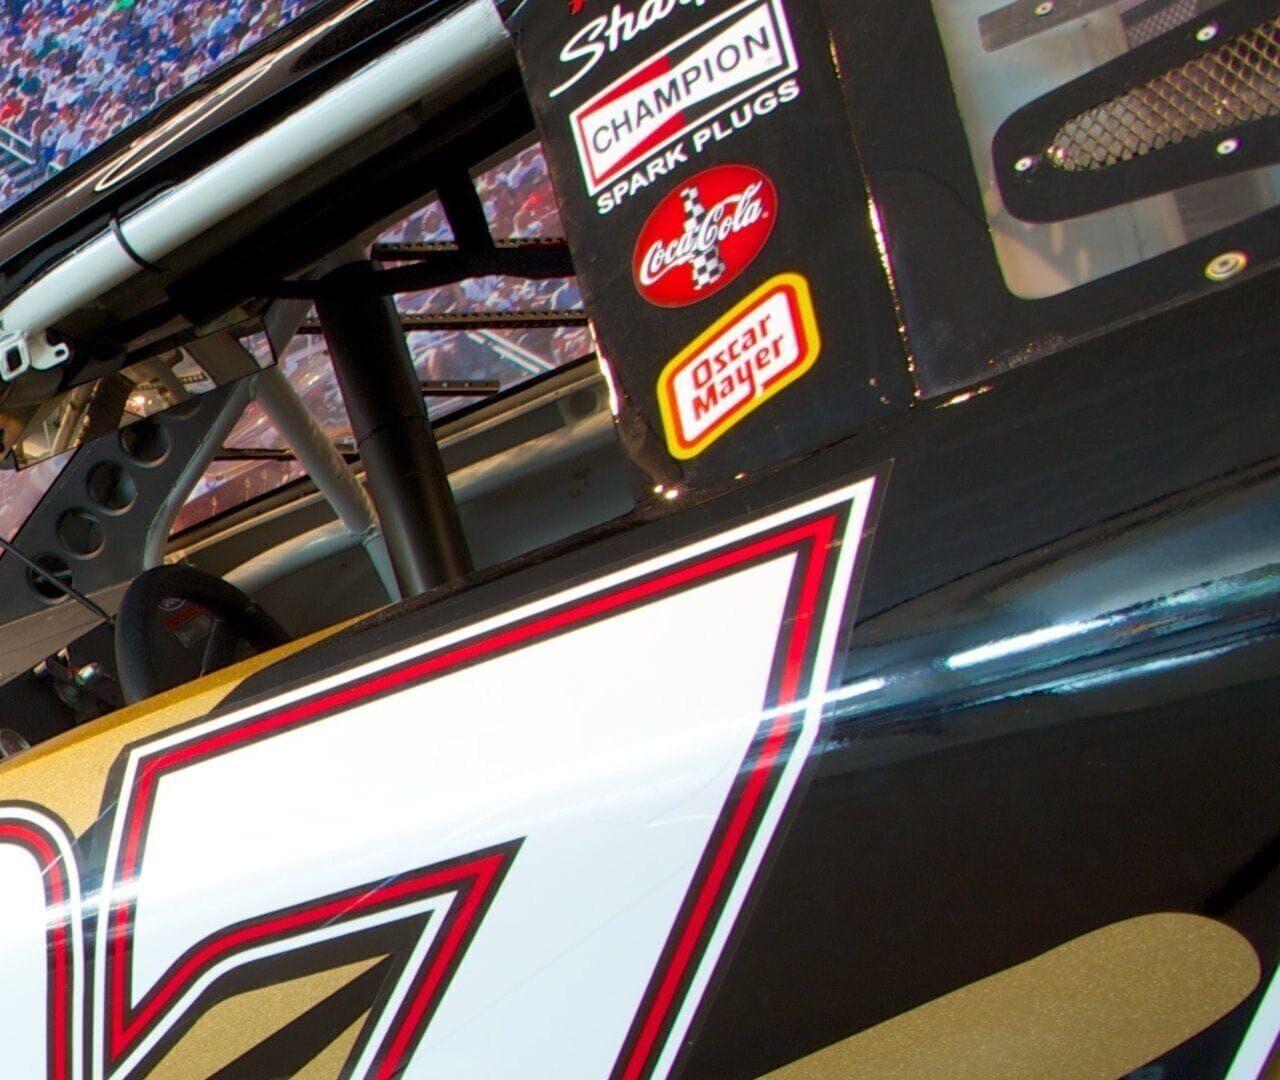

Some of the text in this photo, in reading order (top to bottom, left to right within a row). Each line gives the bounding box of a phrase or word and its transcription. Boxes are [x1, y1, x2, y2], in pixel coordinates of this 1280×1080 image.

[549, 0, 706, 97] Sha
[592, 25, 771, 155] CHAMPION
[596, 79, 801, 215] SPARK PLUGS
[691, 312, 772, 391] Oscar
[692, 332, 784, 422] Mayer
